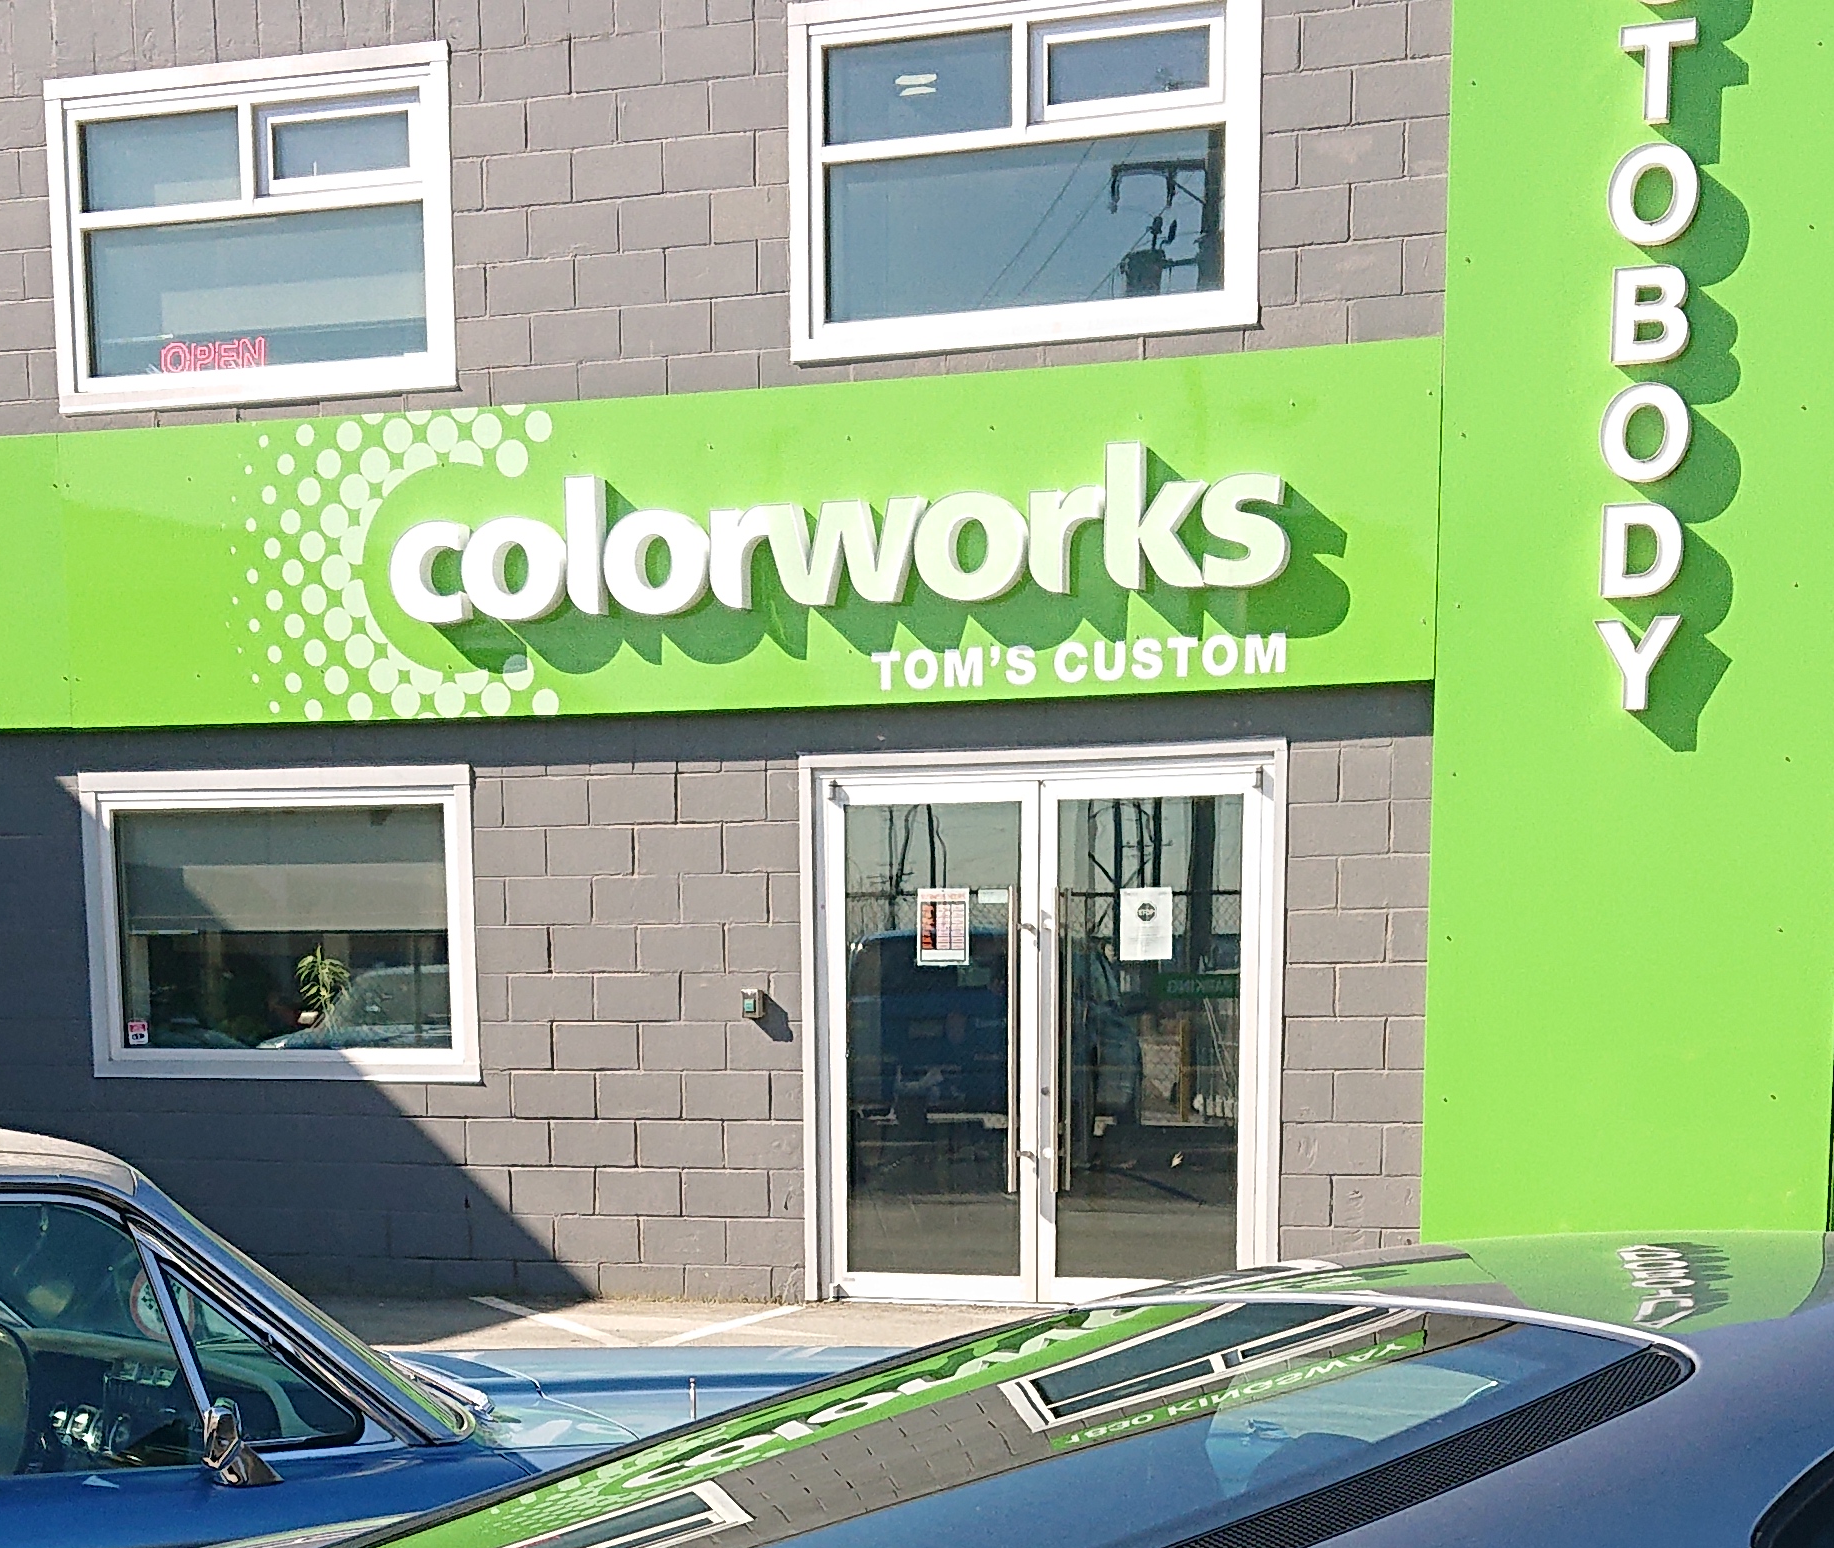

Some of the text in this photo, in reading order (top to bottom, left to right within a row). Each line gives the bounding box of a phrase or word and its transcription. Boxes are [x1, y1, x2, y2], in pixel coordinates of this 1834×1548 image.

[159, 336, 268, 374] OPEN
[1593, 0, 1701, 712] TOBODY
[388, 441, 1287, 625] colorworks
[872, 632, 1287, 692] TOM'S CUSTOM
